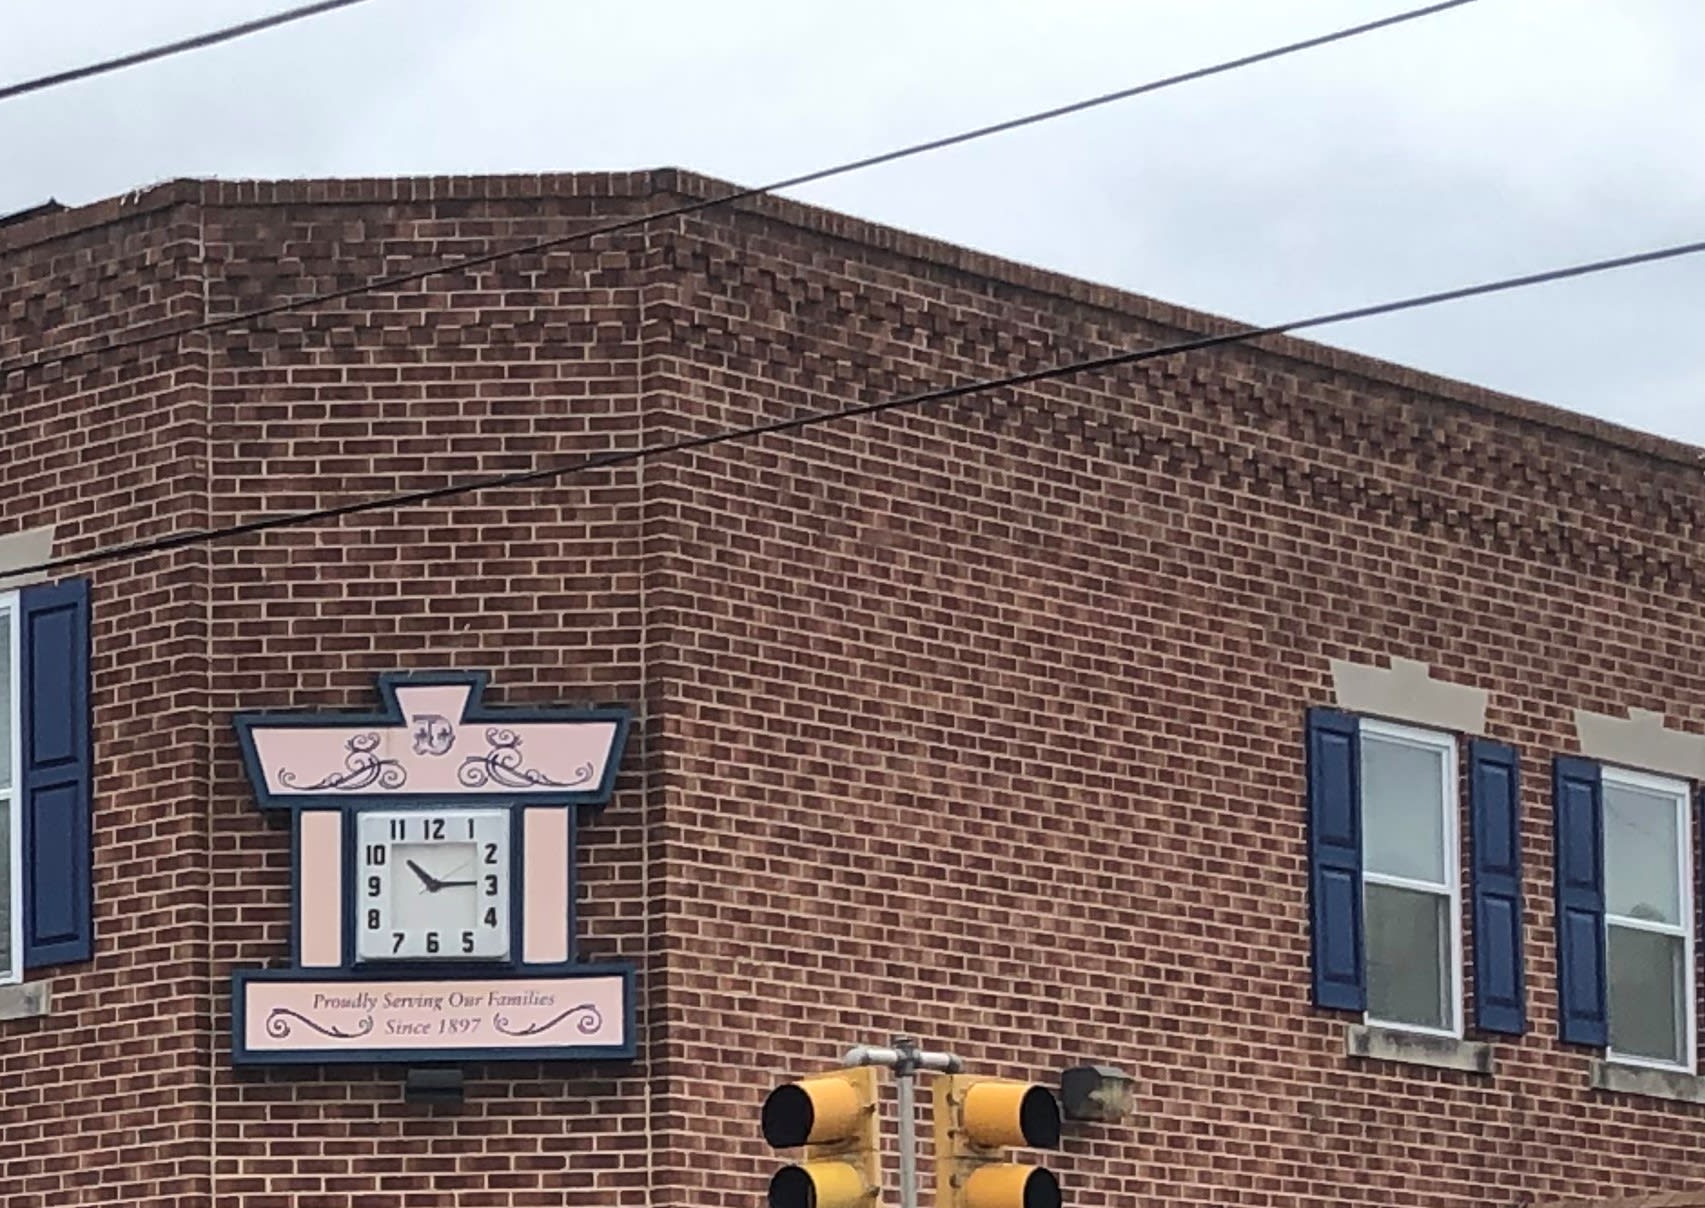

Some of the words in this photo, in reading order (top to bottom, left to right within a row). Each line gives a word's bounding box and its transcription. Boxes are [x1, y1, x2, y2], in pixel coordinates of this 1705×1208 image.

[390, 818, 405, 840] 11
[423, 818, 445, 840] 12
[467, 818, 474, 839] 1
[366, 844, 386, 866] 10
[484, 843, 498, 864] 2
[368, 876, 381, 897] 9
[485, 874, 498, 896] 3
[367, 908, 380, 930] 8
[484, 907, 498, 928] 4
[392, 932, 405, 954] 7
[426, 932, 439, 953] 6
[462, 931, 474, 953] 5
[312, 992, 378, 1012] Proudly
[383, 992, 443, 1011] Serving
[448, 992, 483, 1007] Our
[487, 990, 556, 1007] Families
[384, 1018, 431, 1036] Since
[437, 1017, 482, 1035] 1897
